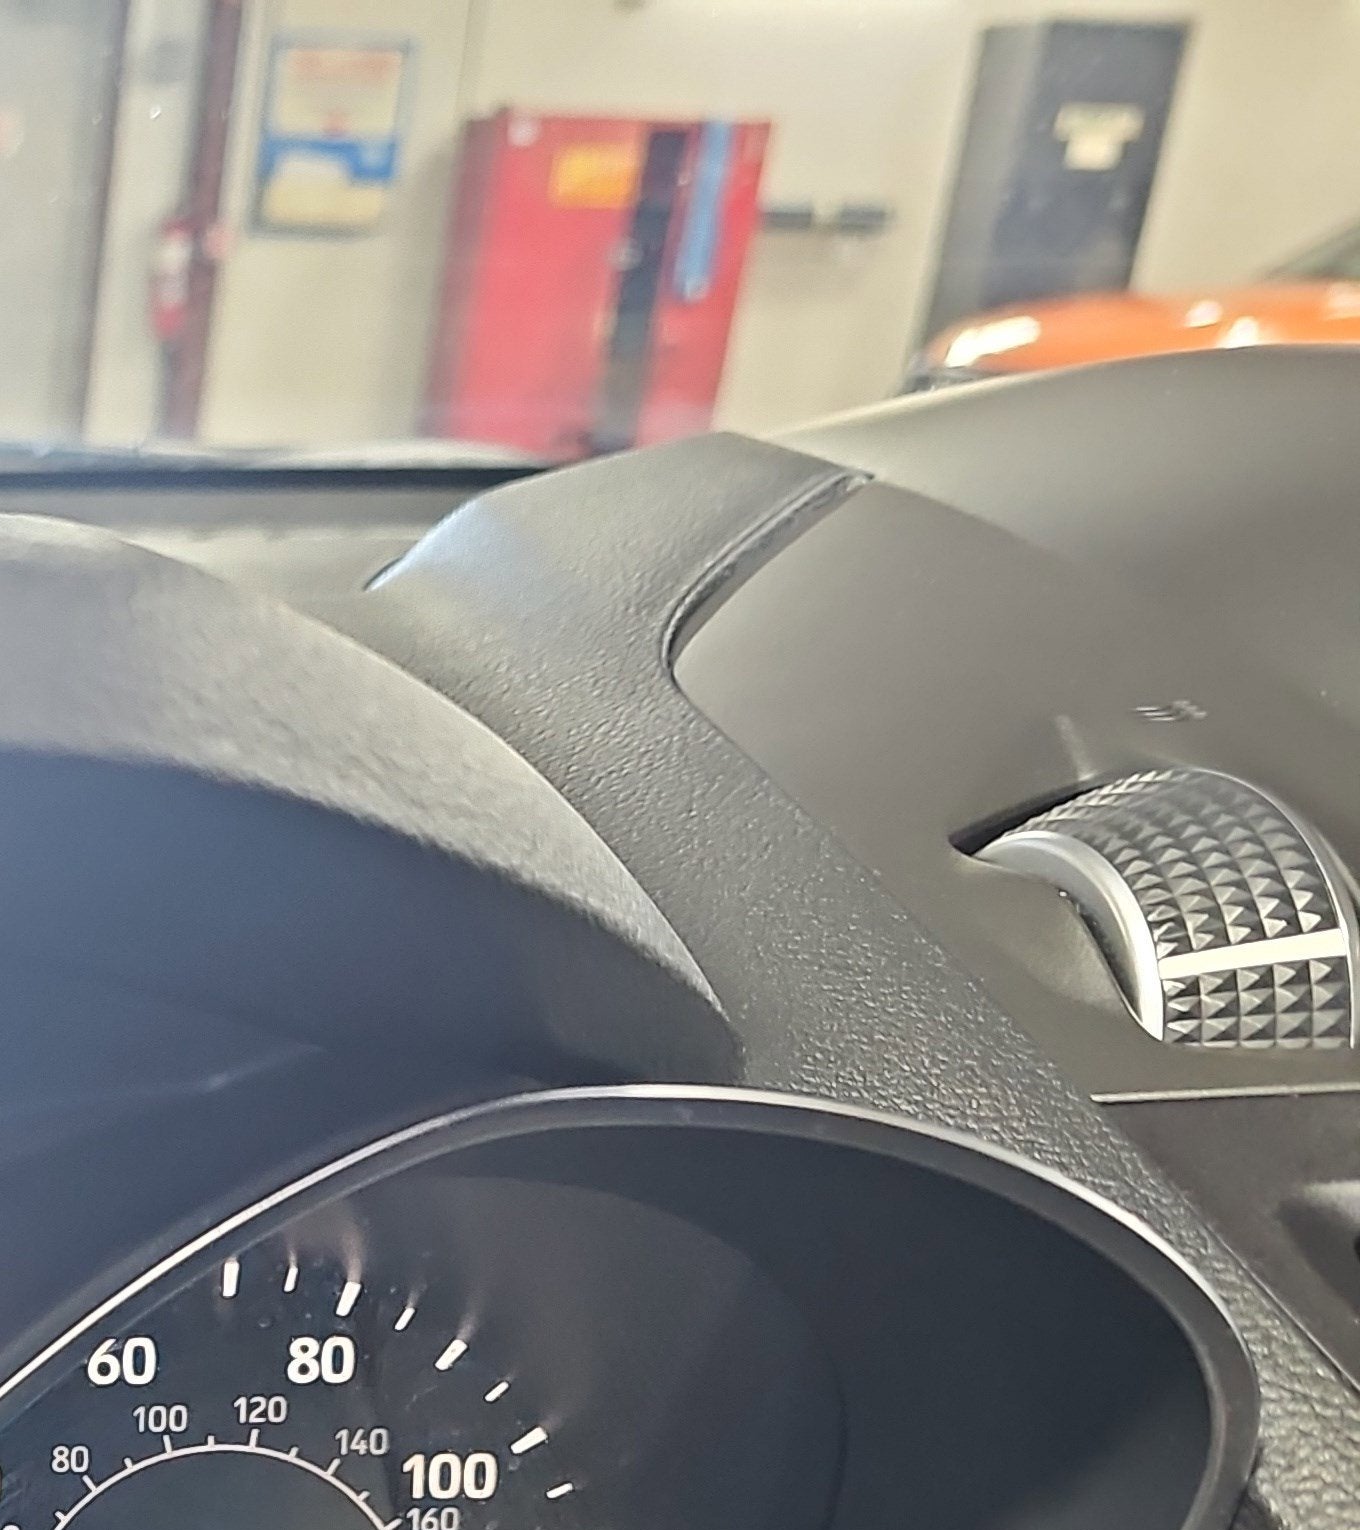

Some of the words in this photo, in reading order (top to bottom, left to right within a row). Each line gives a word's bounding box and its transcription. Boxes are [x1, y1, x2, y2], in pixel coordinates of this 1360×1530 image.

[86, 1337, 158, 1385] 60
[287, 1337, 356, 1385] 80
[133, 1405, 188, 1432] 100
[234, 1396, 287, 1424] 120
[336, 1429, 390, 1455] 140
[51, 1447, 89, 1474] 80
[403, 1453, 498, 1501] 100
